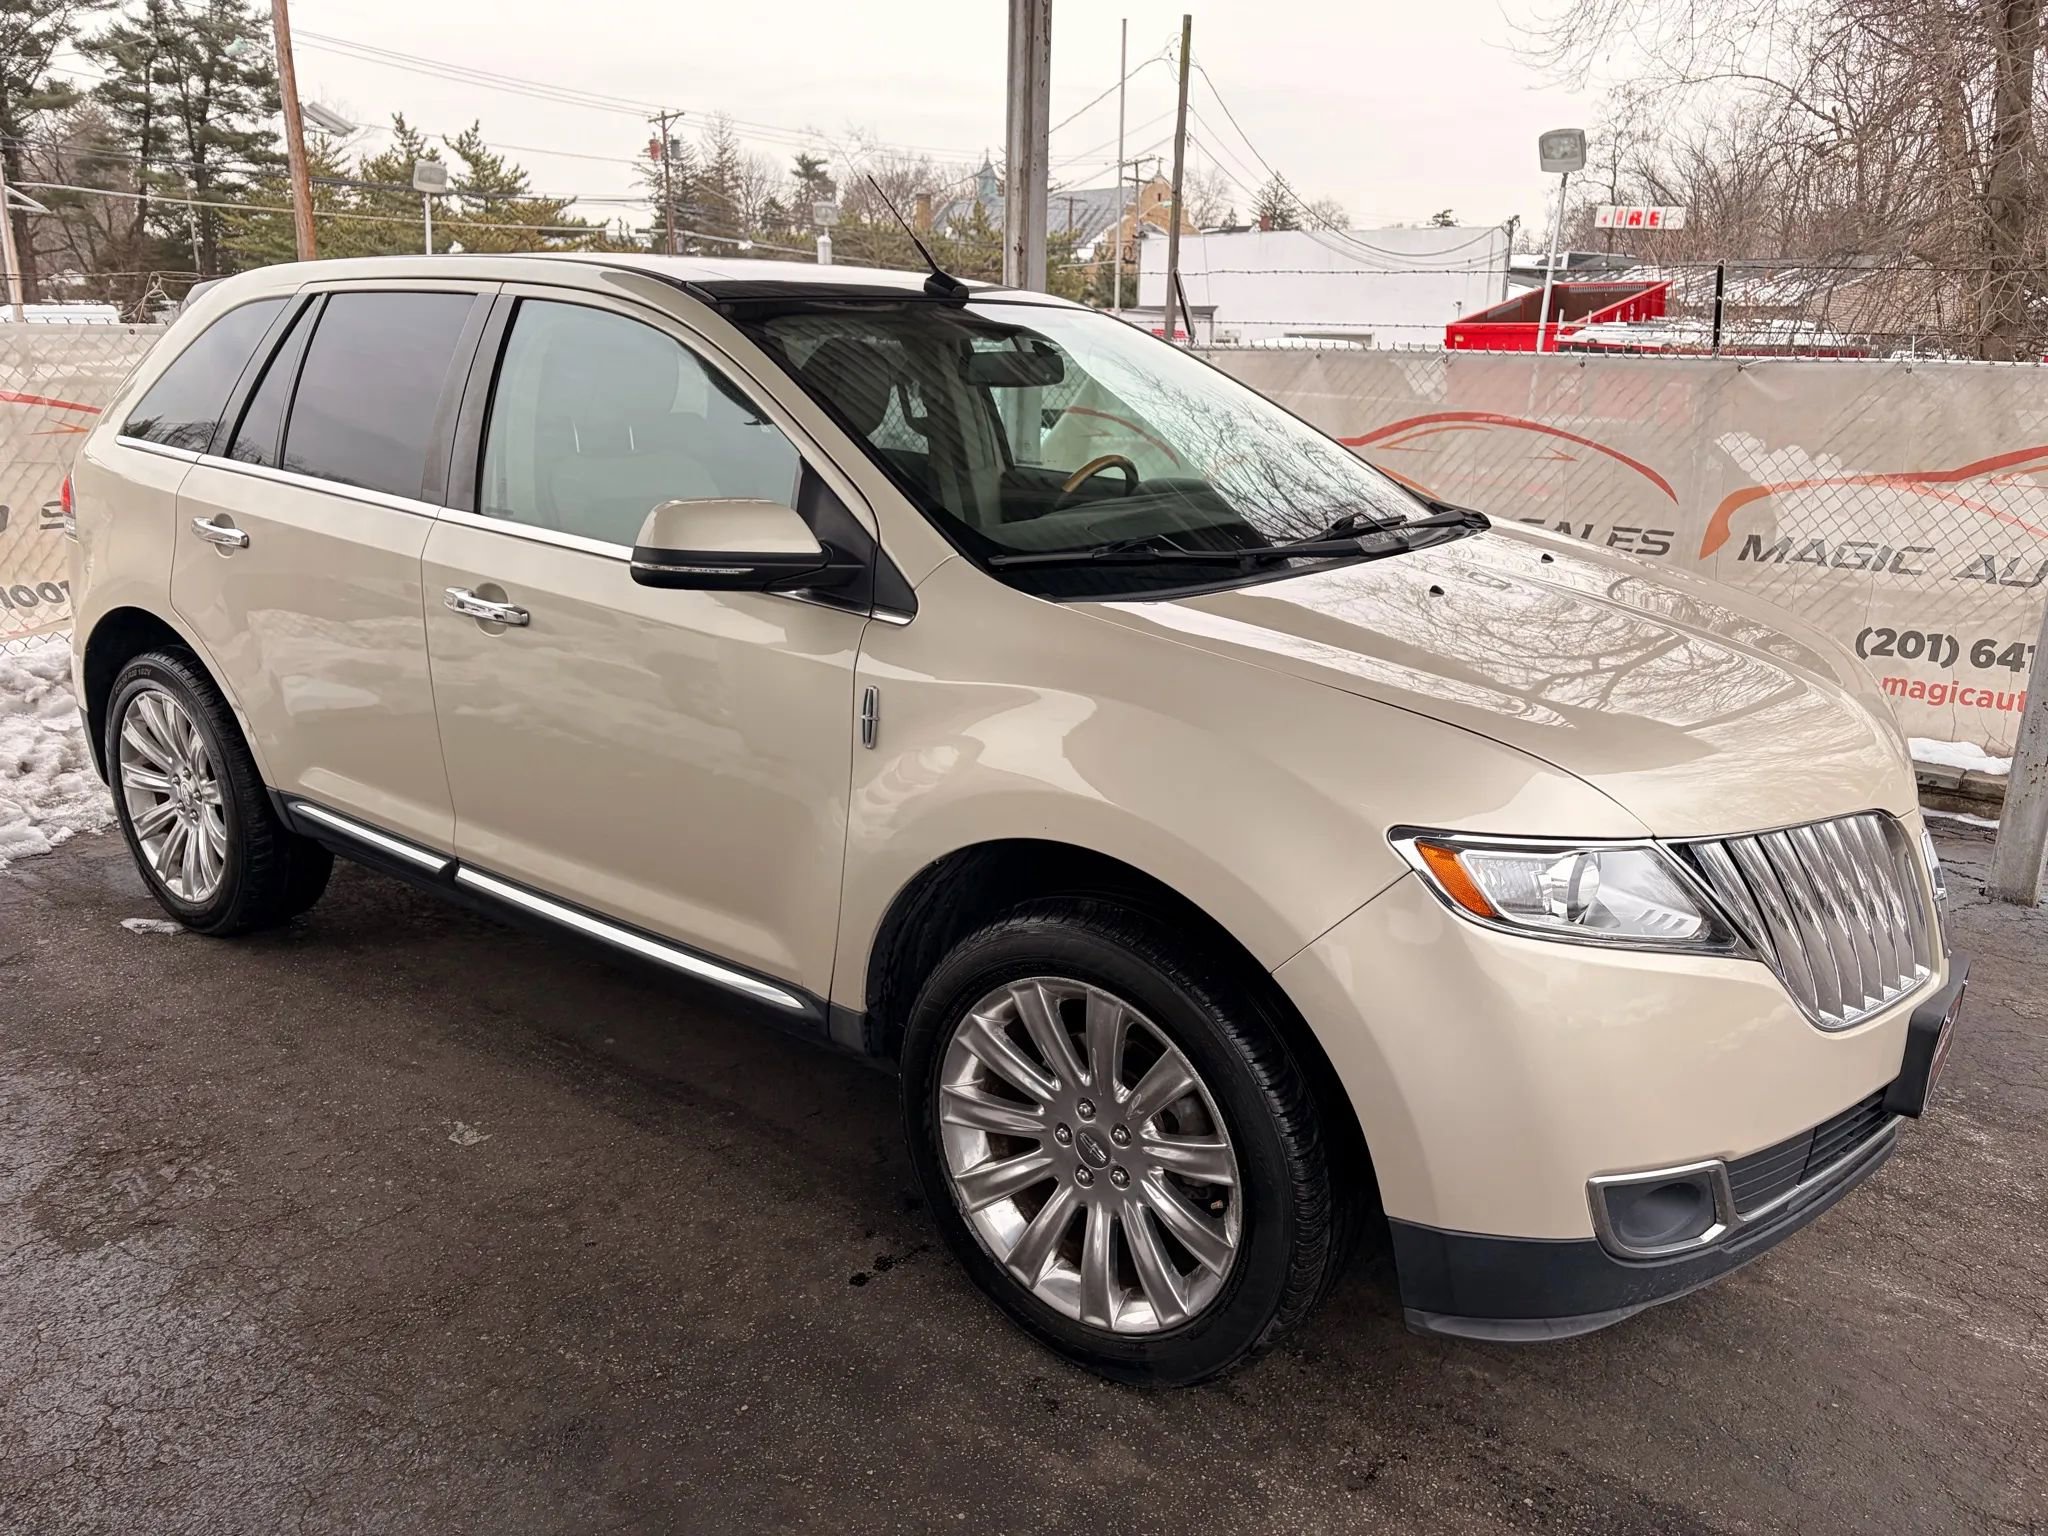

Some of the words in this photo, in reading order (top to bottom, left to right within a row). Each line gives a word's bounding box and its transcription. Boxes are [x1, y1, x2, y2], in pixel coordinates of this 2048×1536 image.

[1600, 210, 1661, 227] IRE
[1737, 534, 1936, 576] MAGIC
[1855, 626, 1960, 669] (201)
